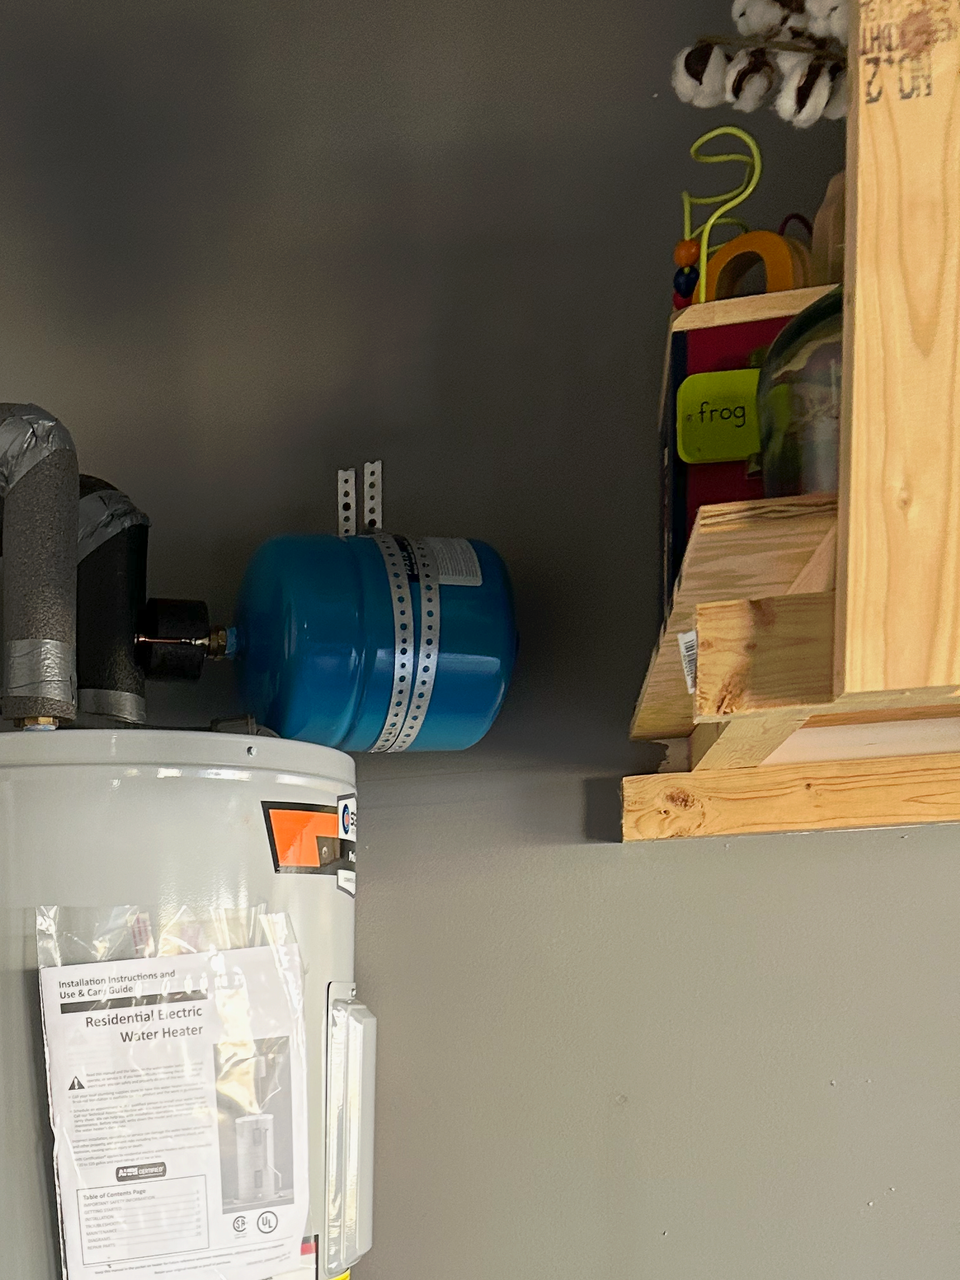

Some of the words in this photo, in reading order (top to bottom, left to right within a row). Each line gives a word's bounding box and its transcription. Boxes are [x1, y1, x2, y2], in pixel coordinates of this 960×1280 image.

[699, 401, 746, 428] frog
[58, 977, 107, 988] Installation
[108, 973, 158, 984] Instructions
[159, 970, 176, 979] and
[59, 990, 76, 999] Use
[77, 989, 86, 997] &
[87, 987, 107, 996] Car
[109, 985, 134, 994] Guide
[85, 1010, 155, 1028] Residential
[120, 1030, 158, 1043] Water
[162, 1026, 204, 1039] Heater
[107, 1190, 132, 1198] Contents
[132, 1188, 147, 1196] Page
[261, 1215, 273, 1229] UL
